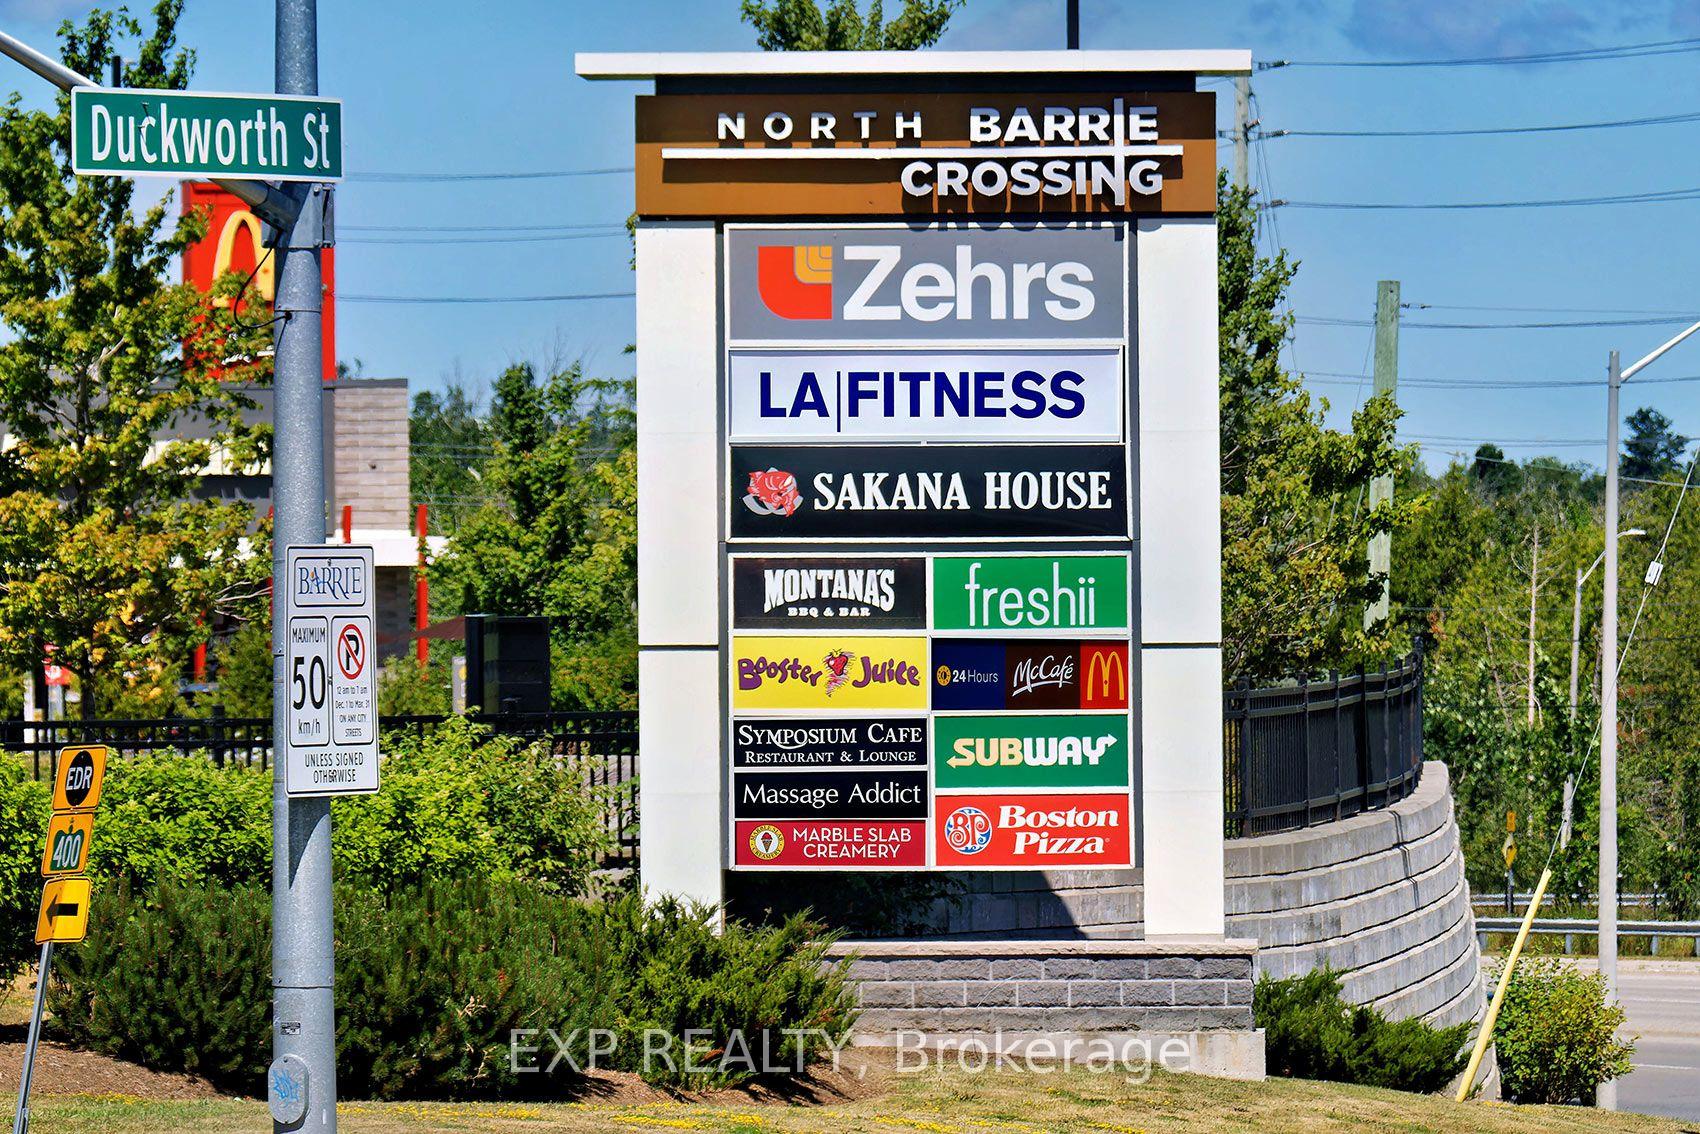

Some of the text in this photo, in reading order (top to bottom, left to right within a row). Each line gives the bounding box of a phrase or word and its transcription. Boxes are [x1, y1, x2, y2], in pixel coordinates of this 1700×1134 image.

[716, 98, 1160, 142] NORTH BARRIE
[90, 103, 330, 169] Duckworth St
[900, 159, 1164, 206] CROSSING
[842, 244, 1096, 322] Zehrs
[813, 470, 1112, 511] SAKANA HOUSE
[298, 566, 362, 600] BARRIE
[763, 568, 896, 613] MONTANA'S
[964, 561, 1096, 627] freshii
[787, 607, 871, 618] BBQ & BAR
[292, 627, 326, 643] MAXIMUM
[292, 655, 326, 710] 50
[737, 656, 920, 691] Booster Juice
[1013, 655, 1074, 693] McCafé
[337, 686, 343, 695] 12
[350, 686, 356, 695] to
[298, 718, 321, 736] km/h
[339, 713, 366, 723] ON ANY CITY
[345, 728, 362, 737] STREETS
[738, 723, 922, 750] SYMPOSIUM CAFE
[305, 752, 364, 768] UNLESS SIGNED
[745, 750, 917, 763] RESTAURANT & LOUNGE
[946, 733, 1118, 769] SUBWAY
[65, 766, 93, 791] EDR
[313, 769, 356, 783] OTHERWISE
[743, 781, 921, 809] Massage Addict
[997, 805, 1119, 829] Boston
[793, 828, 912, 842] MARBLE SLAB
[1013, 831, 1104, 855] Pizza
[52, 834, 83, 868] 400
[803, 844, 900, 858] CREAMERY
